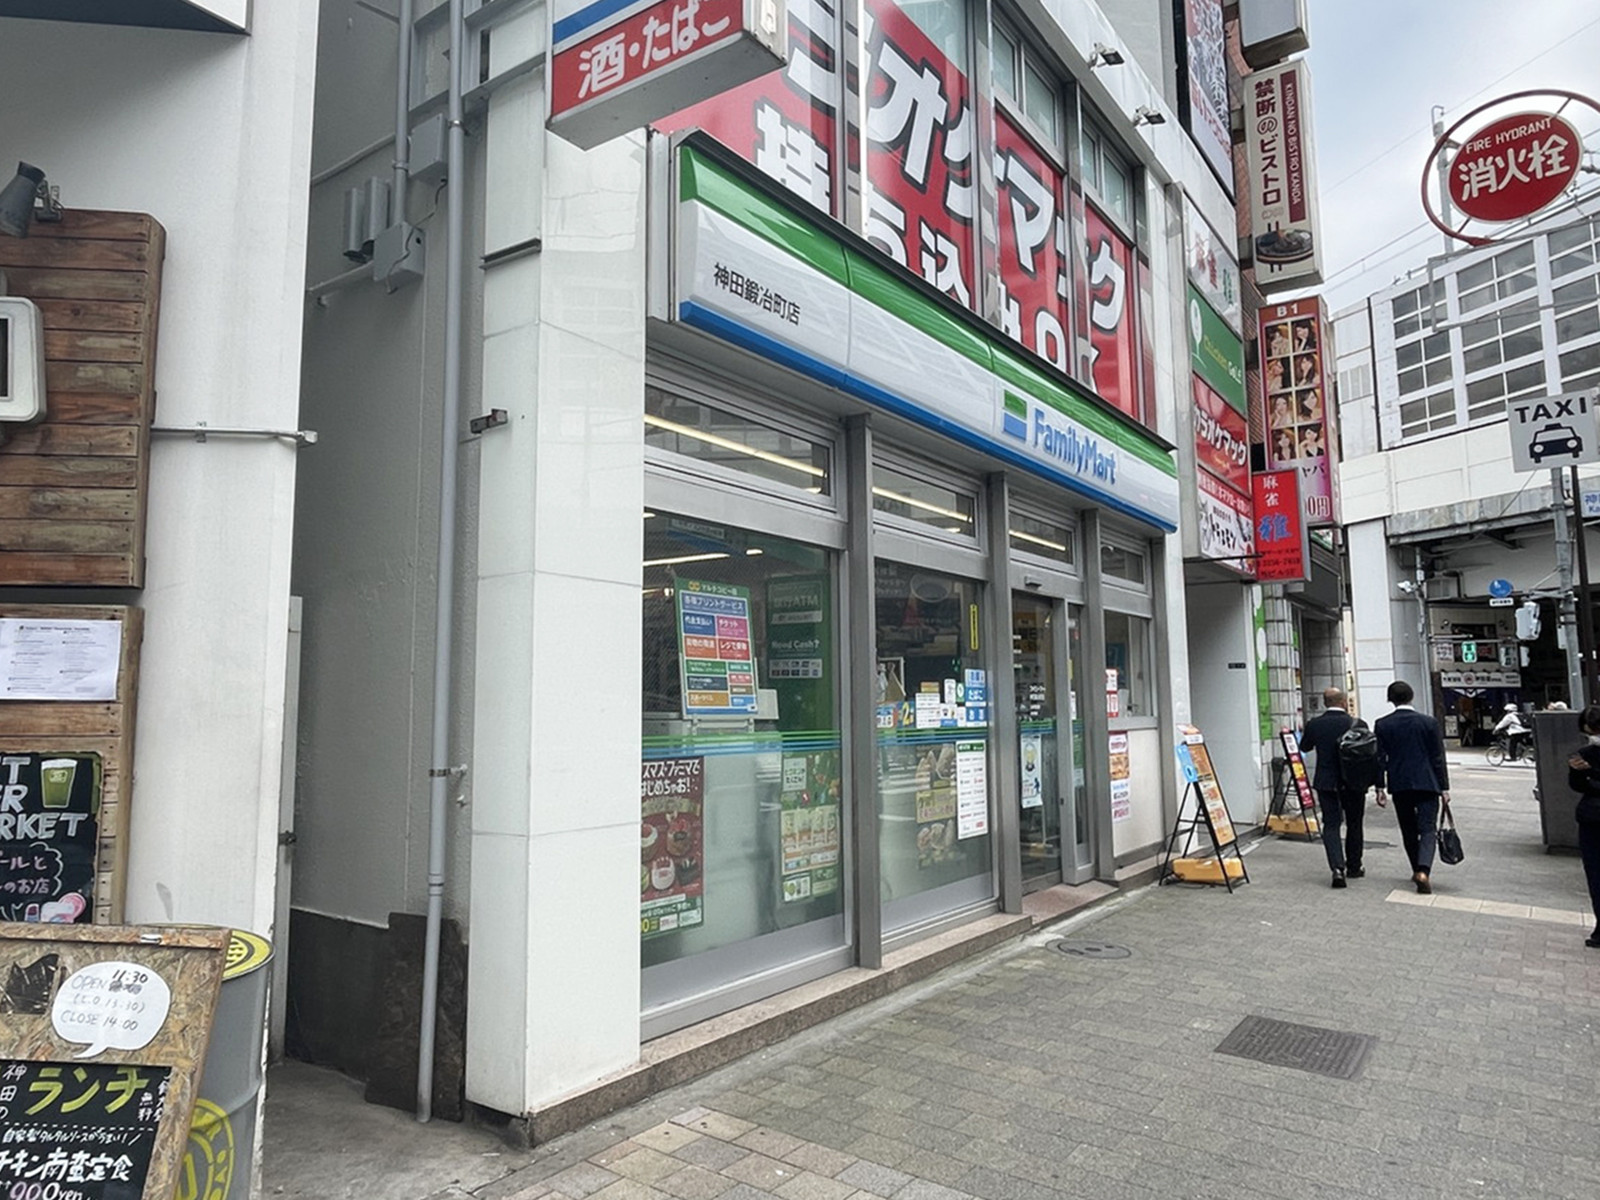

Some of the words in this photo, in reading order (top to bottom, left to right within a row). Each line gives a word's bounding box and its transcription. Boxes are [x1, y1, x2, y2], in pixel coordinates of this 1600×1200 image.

[1465, 136, 1492, 154] FIRE
[1495, 117, 1552, 145] HYDRANT
[1457, 134, 1571, 201] 消火栓
[713, 261, 801, 326] 神田鍛冶町店
[1514, 396, 1587, 424] TAXI
[1032, 407, 1116, 486] FamilyMart
[1263, 475, 1279, 508] 麻雀
[71, 974, 106, 991] OPEN
[112, 969, 149, 984] 11:30
[60, 1010, 98, 1026] CLOSE
[25, 1066, 150, 1116] ランチ
